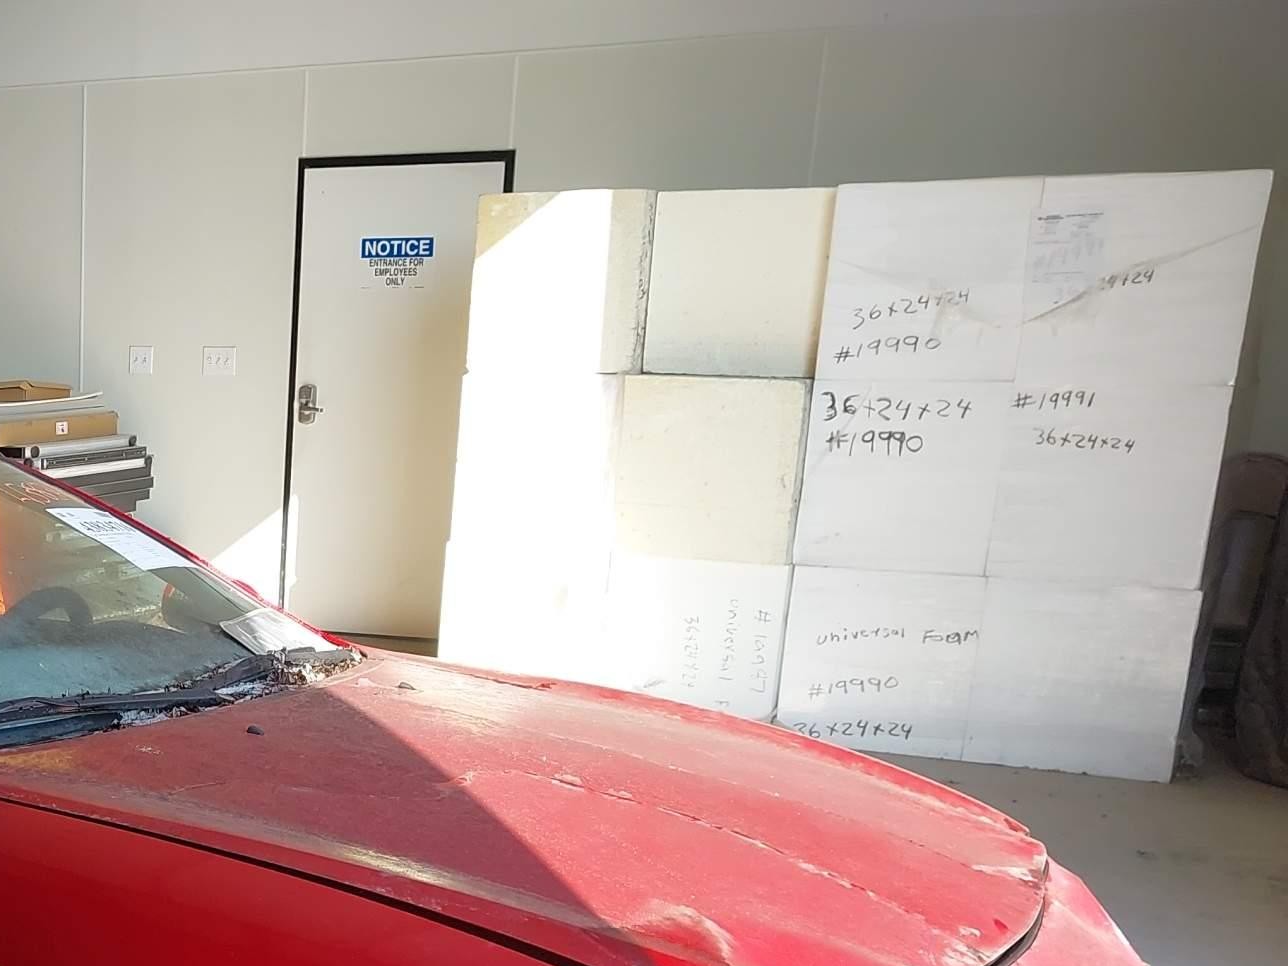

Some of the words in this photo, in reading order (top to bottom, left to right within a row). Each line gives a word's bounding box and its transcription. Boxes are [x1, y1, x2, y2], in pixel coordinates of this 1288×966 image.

[365, 240, 430, 256] NOTICE
[369, 258, 407, 267] ENTRANCE
[409, 258, 424, 267] FOR
[374, 267, 418, 277] EMPLOYEES
[385, 277, 405, 286] ONLY
[833, 335, 942, 364] #19990
[1010, 390, 1096, 410] #19991
[825, 429, 924, 457] #19990
[808, 676, 900, 699] #19990
